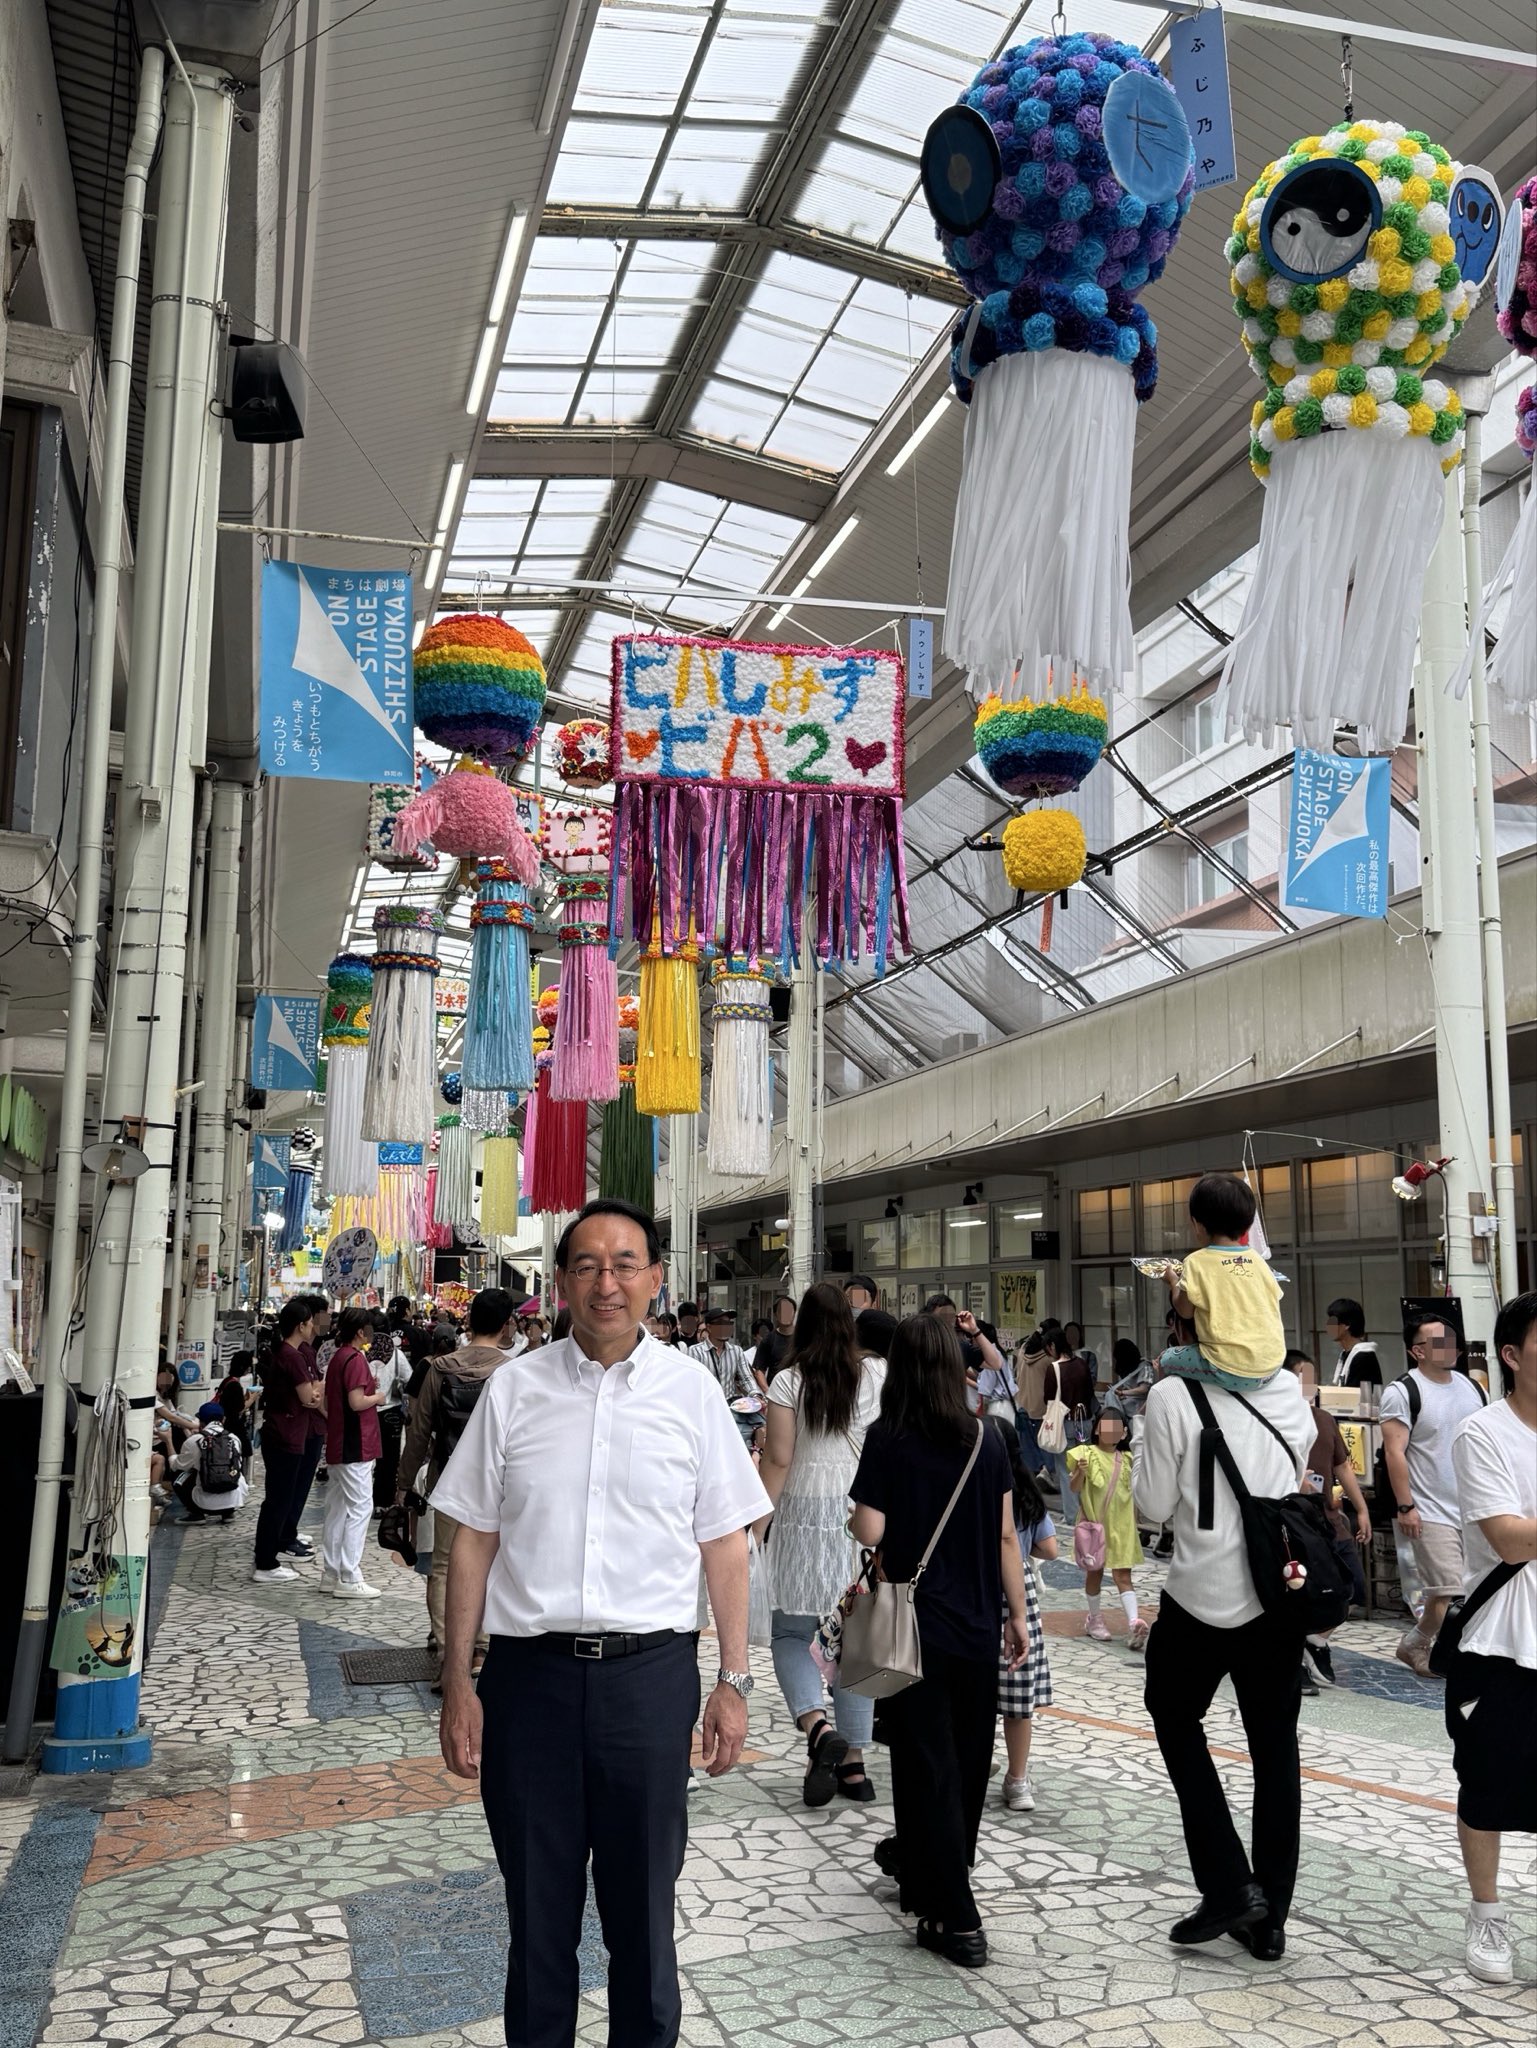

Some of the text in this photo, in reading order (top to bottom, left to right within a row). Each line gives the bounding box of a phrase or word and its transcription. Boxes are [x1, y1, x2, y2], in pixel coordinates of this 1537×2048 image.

[1190, 38, 1216, 174] ふじ乃や
[327, 577, 406, 593] まちは劇場
[328, 595, 350, 626] ON
[356, 596, 378, 673] STAGE
[384, 596, 407, 724] SHIZUOKA
[272, 715, 288, 767] みつける
[291, 699, 304, 753] きょうを
[308, 683, 323, 772] いつもとちがう
[1314, 767, 1334, 827] STAGE
[1337, 770, 1354, 794] ON
[1295, 763, 1314, 861] SHIZUOKA
[1368, 839, 1379, 914] 私の最高傑作は
[284, 1008, 294, 1022] ON
[295, 1009, 307, 1044] STAGE
[305, 1010, 317, 1065] SHIZUOKA
